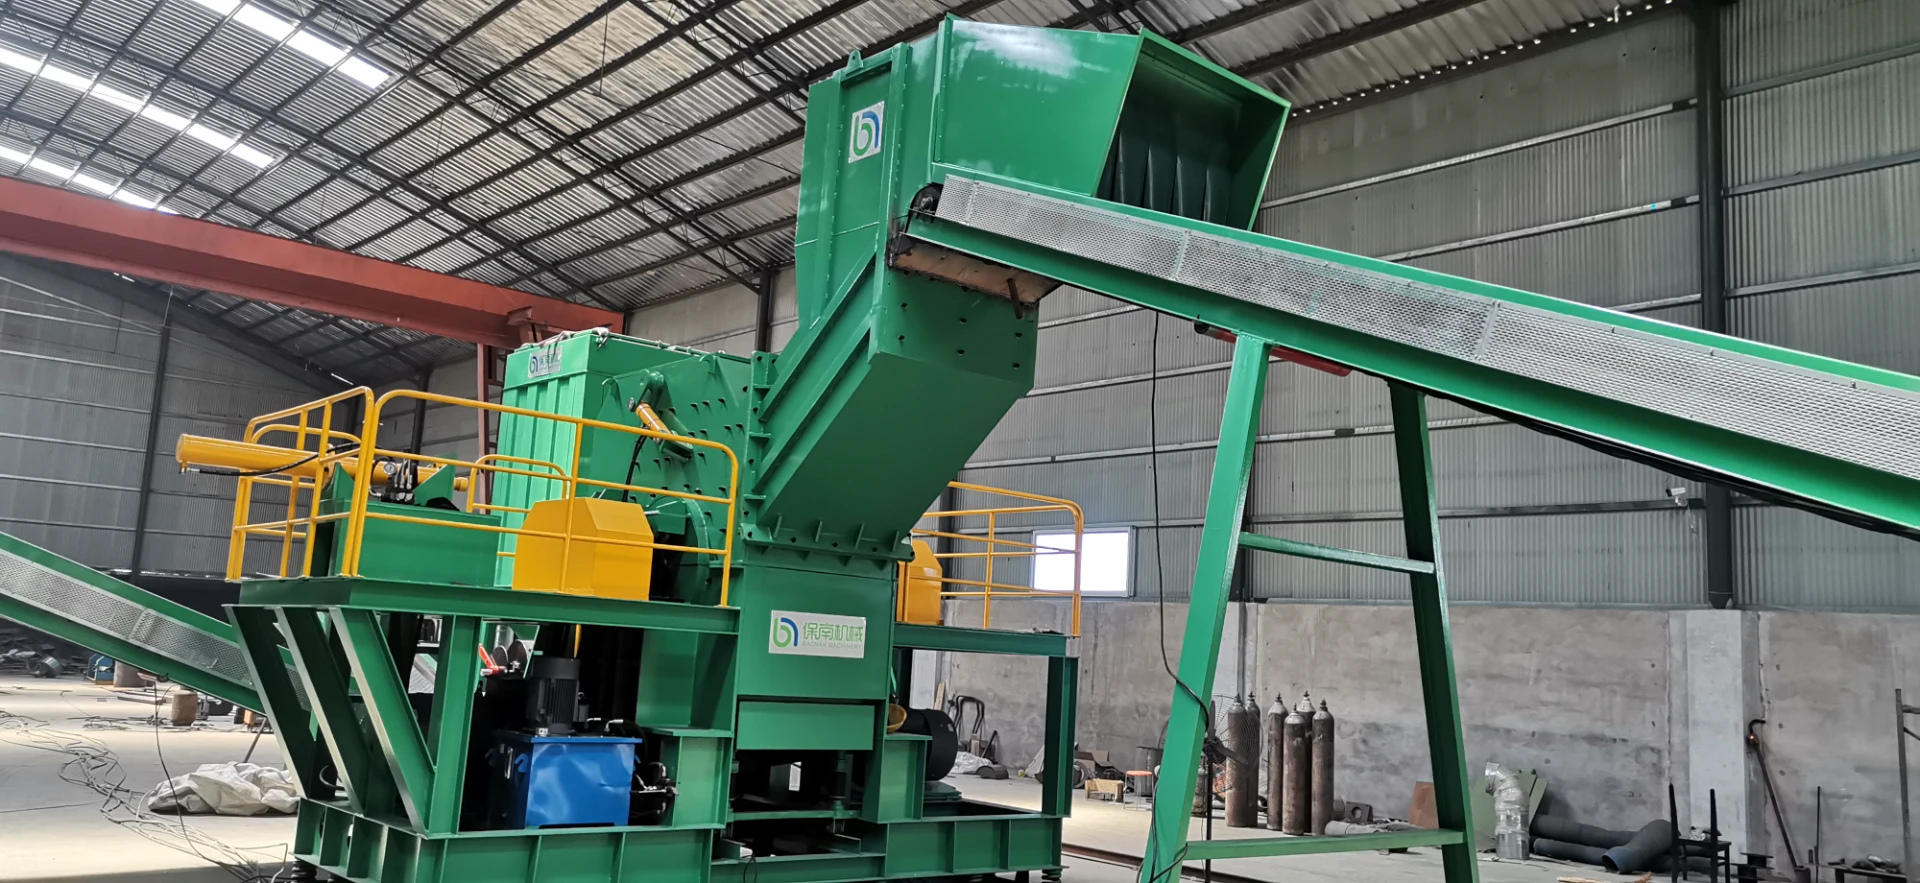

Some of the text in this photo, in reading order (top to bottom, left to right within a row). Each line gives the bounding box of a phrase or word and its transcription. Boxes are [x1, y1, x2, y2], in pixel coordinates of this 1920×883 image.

[802, 622, 864, 642] 保南机械
[828, 642, 863, 650] MACHINERY
